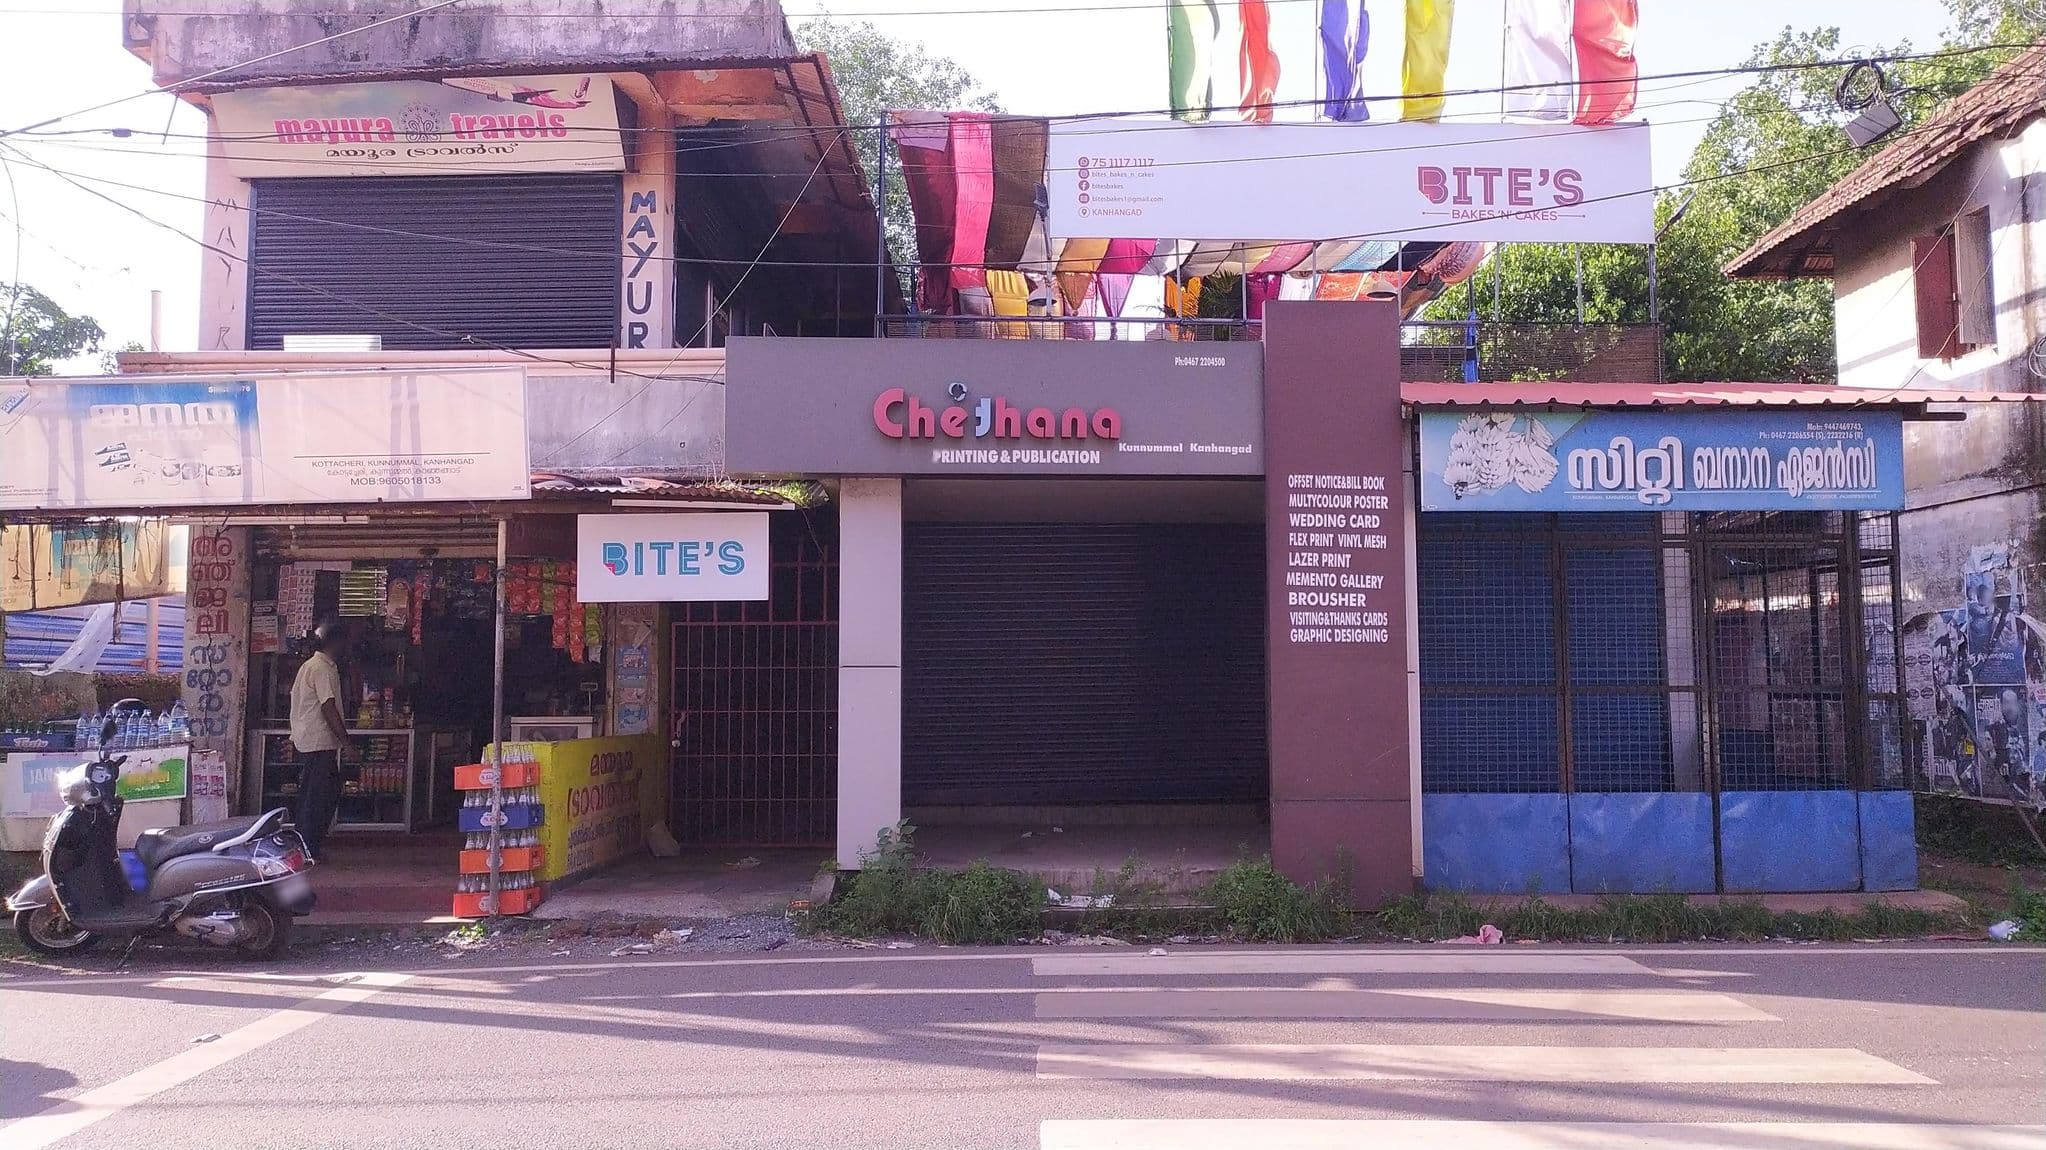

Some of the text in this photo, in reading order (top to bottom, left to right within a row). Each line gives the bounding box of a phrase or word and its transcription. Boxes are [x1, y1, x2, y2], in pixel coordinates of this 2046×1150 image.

[273, 110, 568, 144] mayura travels
[1418, 166, 1585, 207] BITE'S
[1092, 208, 1143, 216] KANHANGAD
[1452, 209, 1495, 220] BAKES
[1514, 211, 1558, 221] CAKES
[873, 387, 1122, 439] Chethana
[1118, 442, 1252, 455] Kunnummal Kanhangad
[1012, 450, 1100, 464] PUBLICATION
[1568, 436, 1876, 505] സിറ്റി ബനാന ഏജൻസി
[1288, 474, 1385, 490] OFFSET NOTICE&BILL BOOK
[1288, 494, 1388, 510] MULTYCOLOUR POSTER
[1289, 513, 1380, 528] WEDDING CARD
[1289, 532, 1387, 549] FLEX PRINT VINYL MESH
[602, 540, 746, 576] BITE'S
[1288, 552, 1352, 568] LAZER PRINT
[1286, 572, 1384, 590] MEMENTO GALLERY
[1288, 592, 1366, 607] BROUSHER
[1290, 612, 1388, 626] VISITING&THANKS CARDS
[1290, 628, 1388, 643] GRAPHIC DESIGNING
